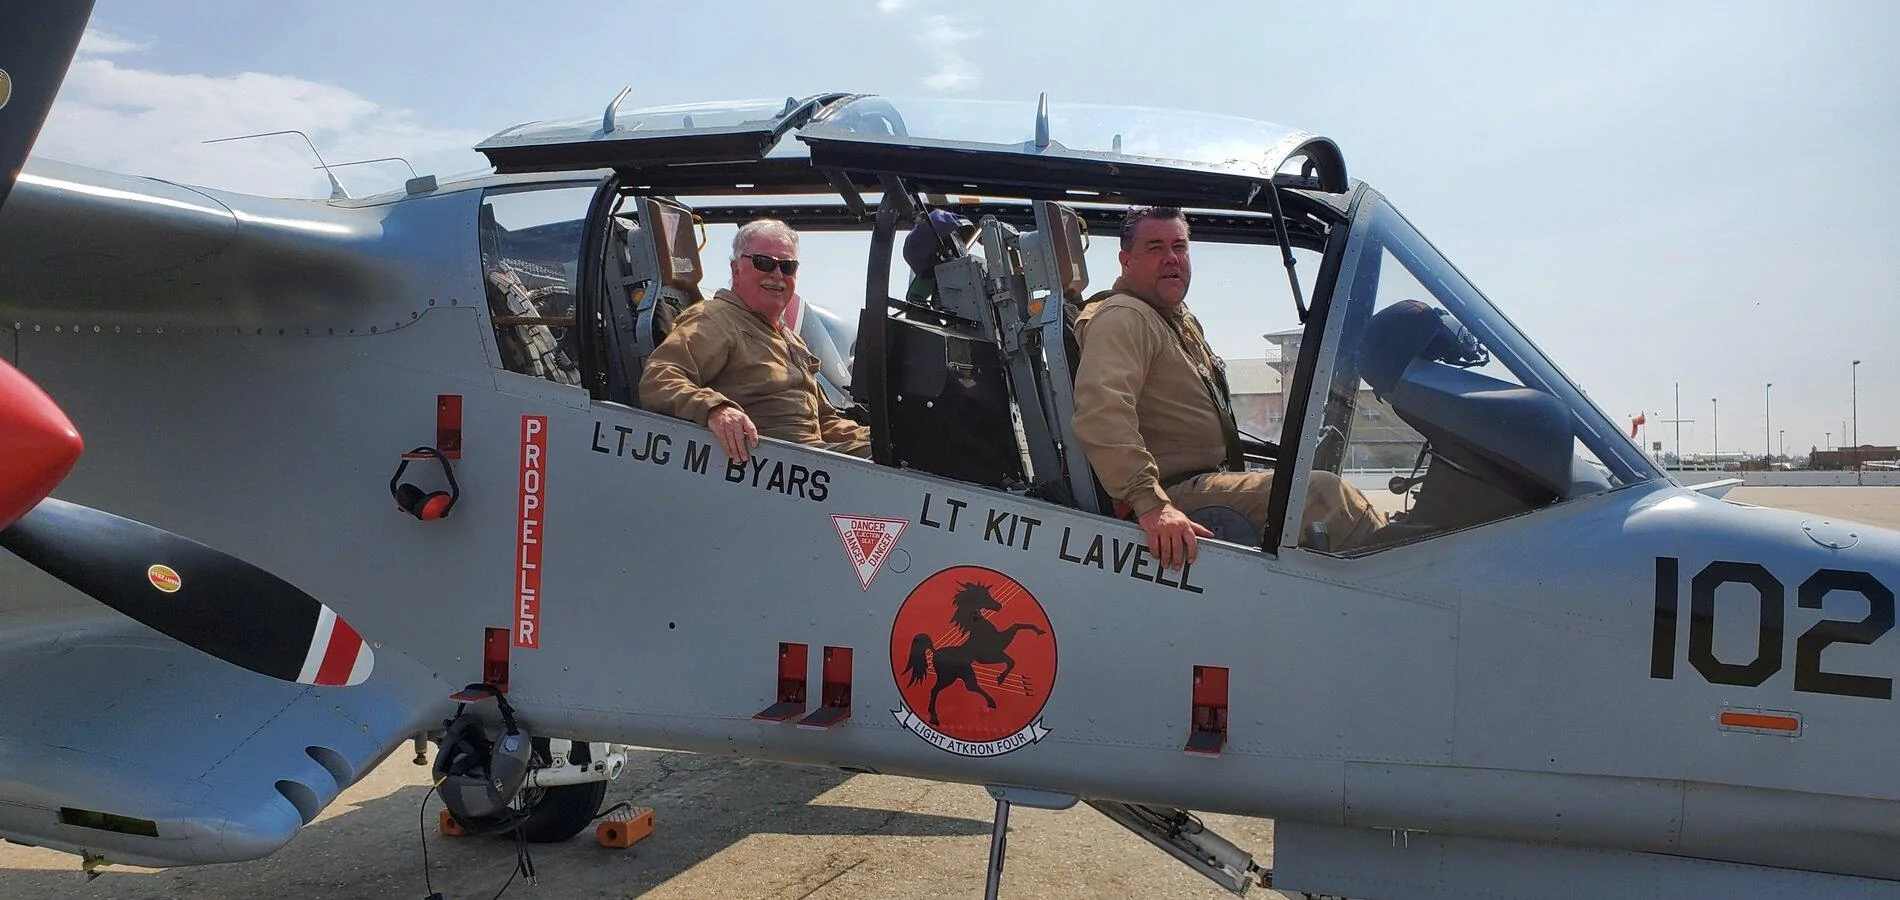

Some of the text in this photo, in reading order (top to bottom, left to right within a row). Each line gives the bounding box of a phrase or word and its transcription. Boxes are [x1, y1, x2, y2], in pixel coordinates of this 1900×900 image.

[591, 421, 831, 502] LTJG M BYARS
[519, 418, 541, 645] PROPELLER
[844, 530, 866, 566] DANGER
[851, 520, 886, 532] DANGER
[868, 532, 893, 567] DANGER
[919, 493, 1204, 594] LT KIT LAVELL
[1650, 556, 1895, 700] 102
[914, 721, 1027, 755] LIGHT ATKRON FOUR
